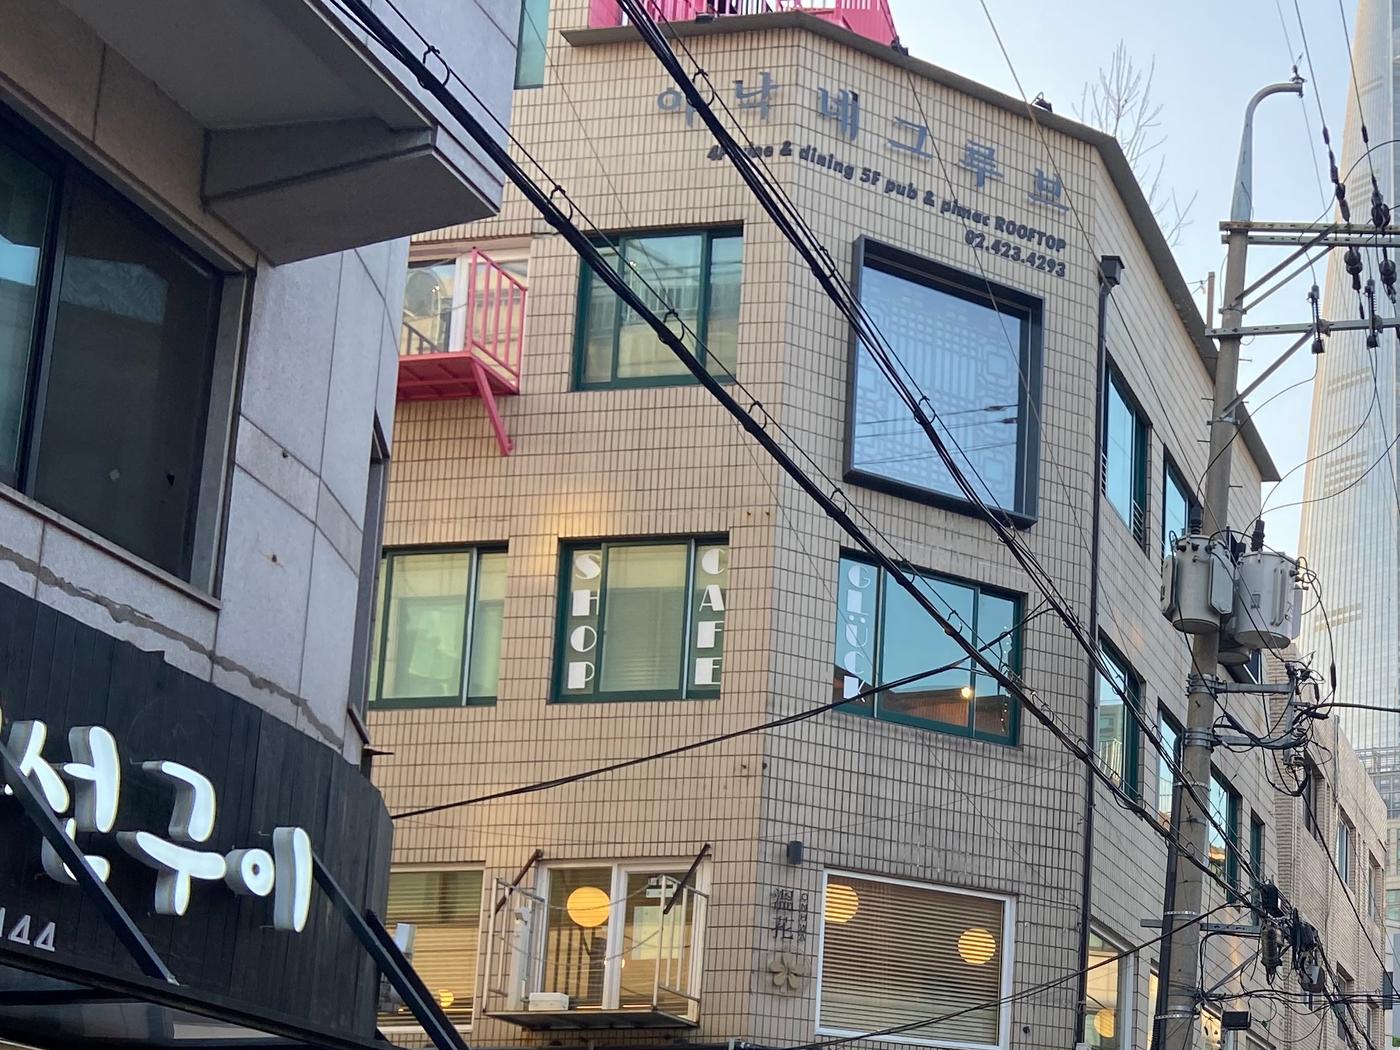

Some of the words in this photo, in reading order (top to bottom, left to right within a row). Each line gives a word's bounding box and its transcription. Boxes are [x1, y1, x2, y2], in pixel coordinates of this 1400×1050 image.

[780, 139, 793, 157] &
[799, 143, 855, 181] dining
[860, 166, 881, 186] 5F
[885, 177, 918, 201] pub
[922, 189, 935, 207] &
[995, 214, 1067, 253] ROOFTOP
[965, 228, 1067, 279] 02.423.4293
[567, 552, 602, 690] SHOP
[694, 547, 727, 686] CAFE
[843, 563, 873, 704] GLÜCK
[4, 717, 314, 934] 선구이
